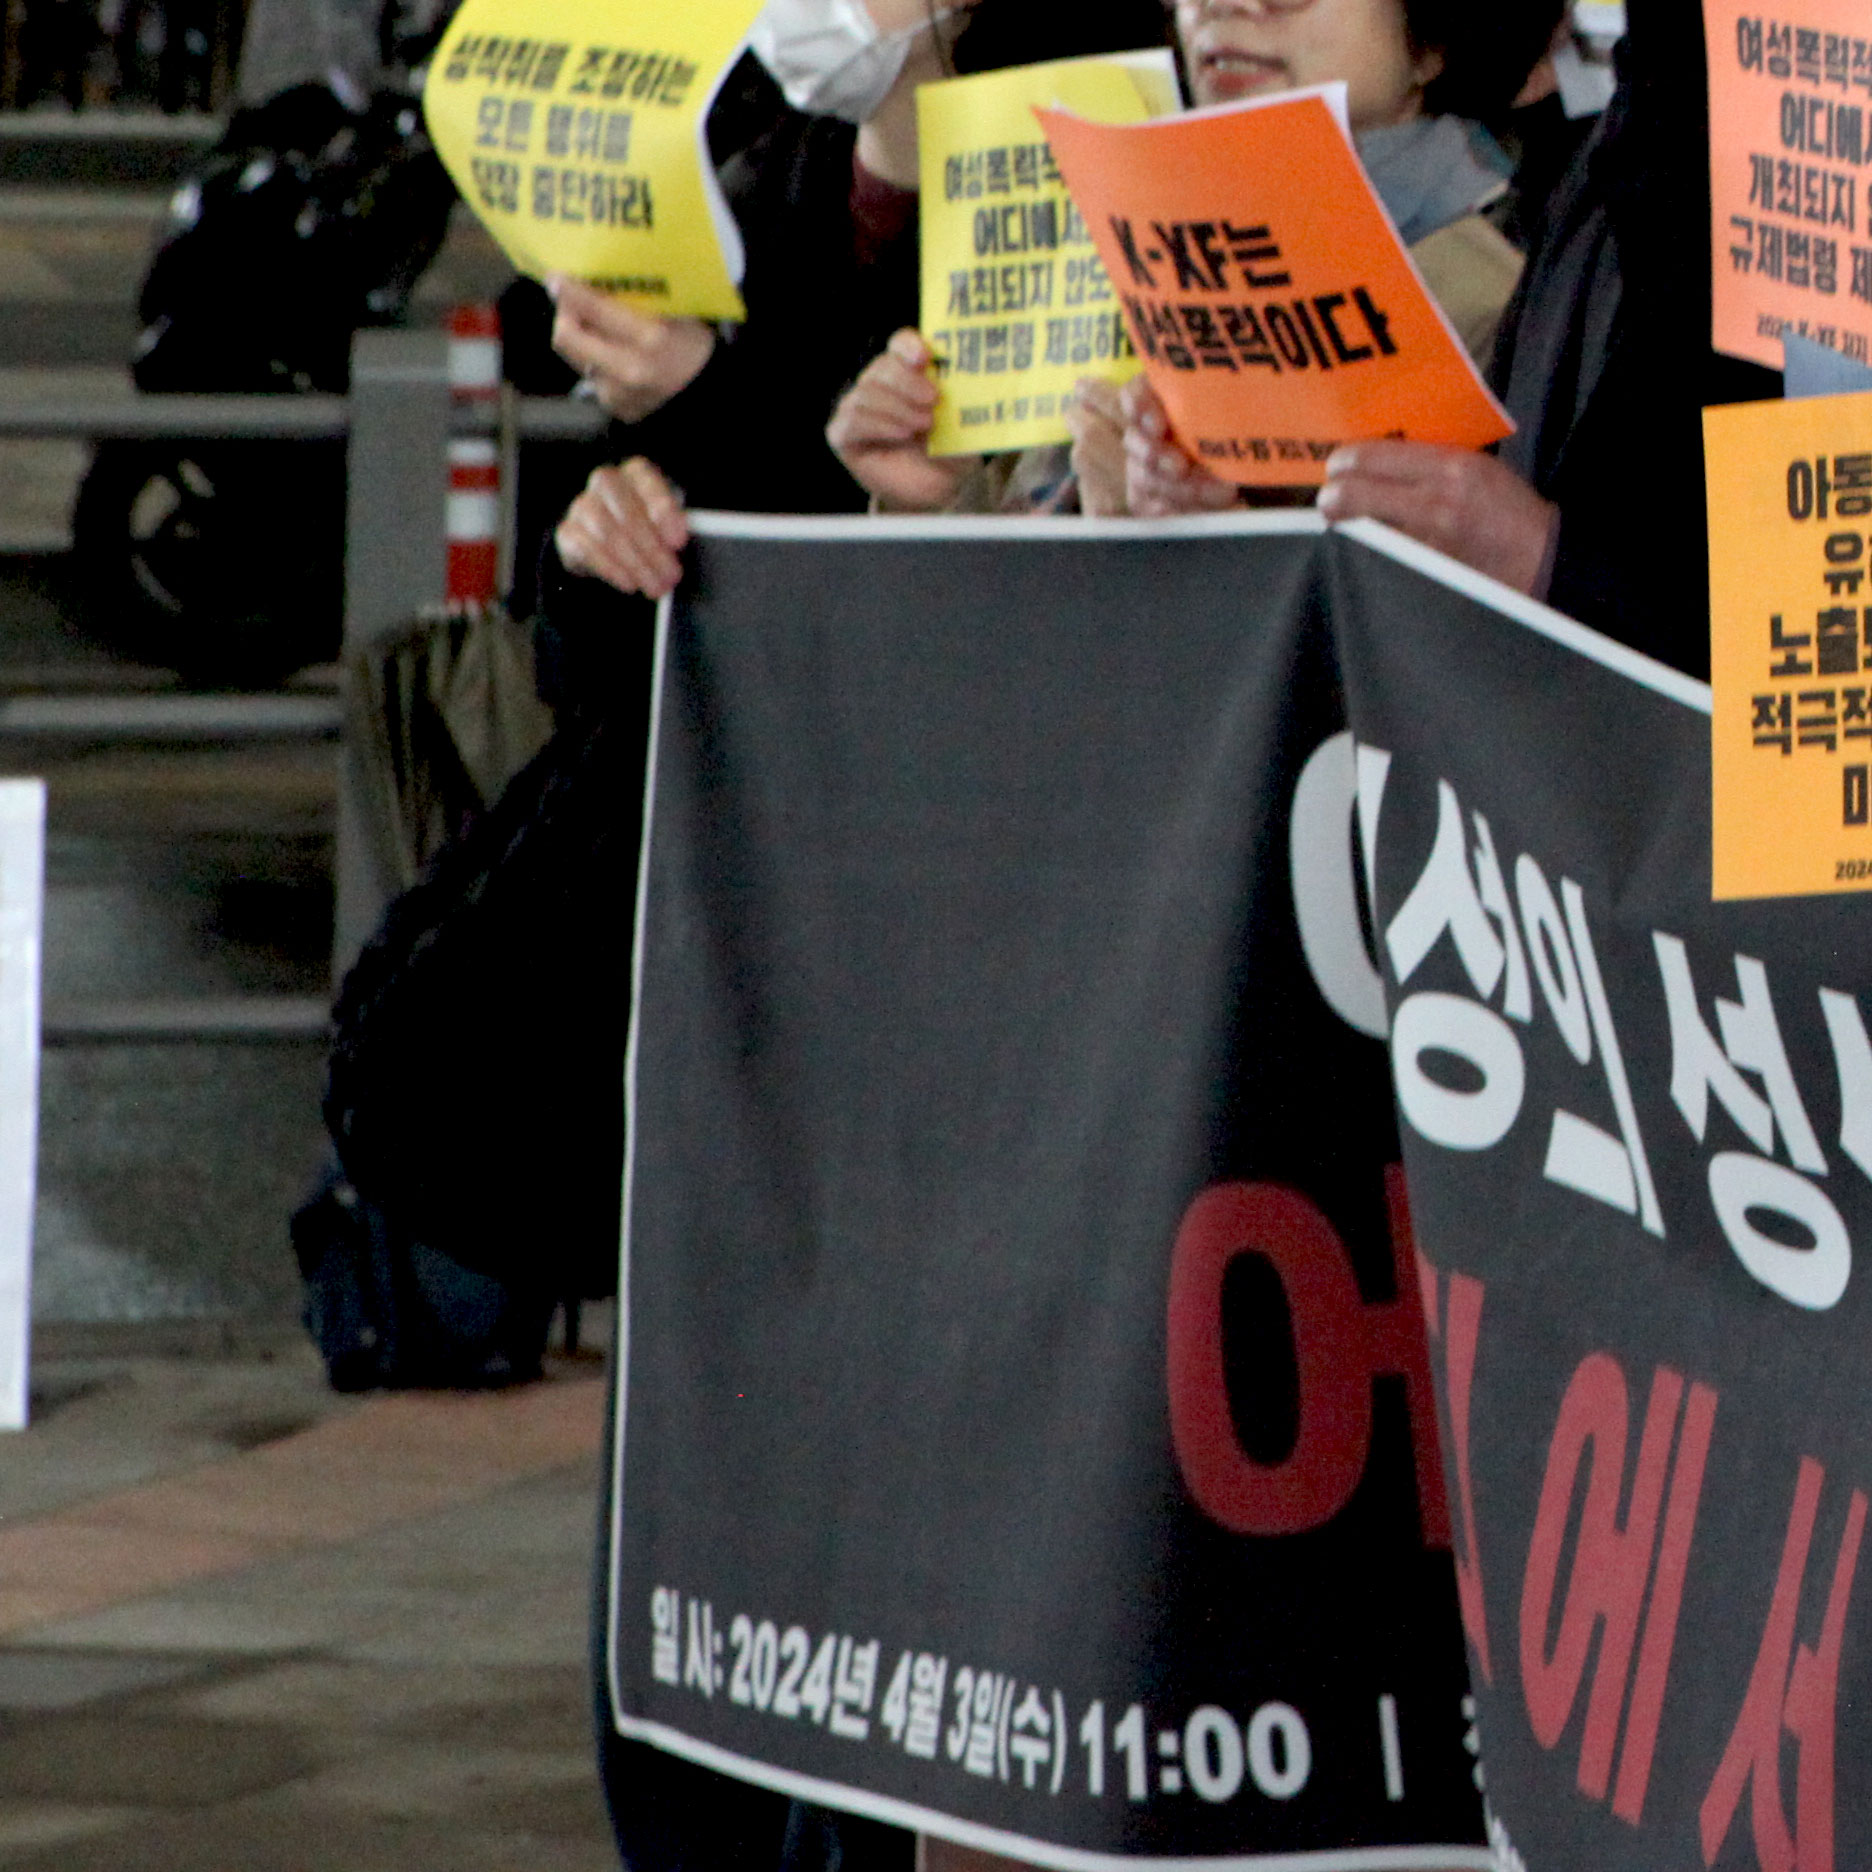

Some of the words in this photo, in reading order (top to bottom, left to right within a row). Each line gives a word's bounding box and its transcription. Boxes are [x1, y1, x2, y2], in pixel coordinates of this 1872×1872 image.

[1749, 153, 1855, 232] 개최되지
[1109, 215, 1291, 291] K-XF는
[1729, 214, 1837, 295] 규제법령
[729, 1614, 880, 1740] 2024년
[882, 1649, 948, 1760] 4월
[949, 1666, 1068, 1795] 3일(수)
[1080, 1698, 1312, 1804] 11:00
